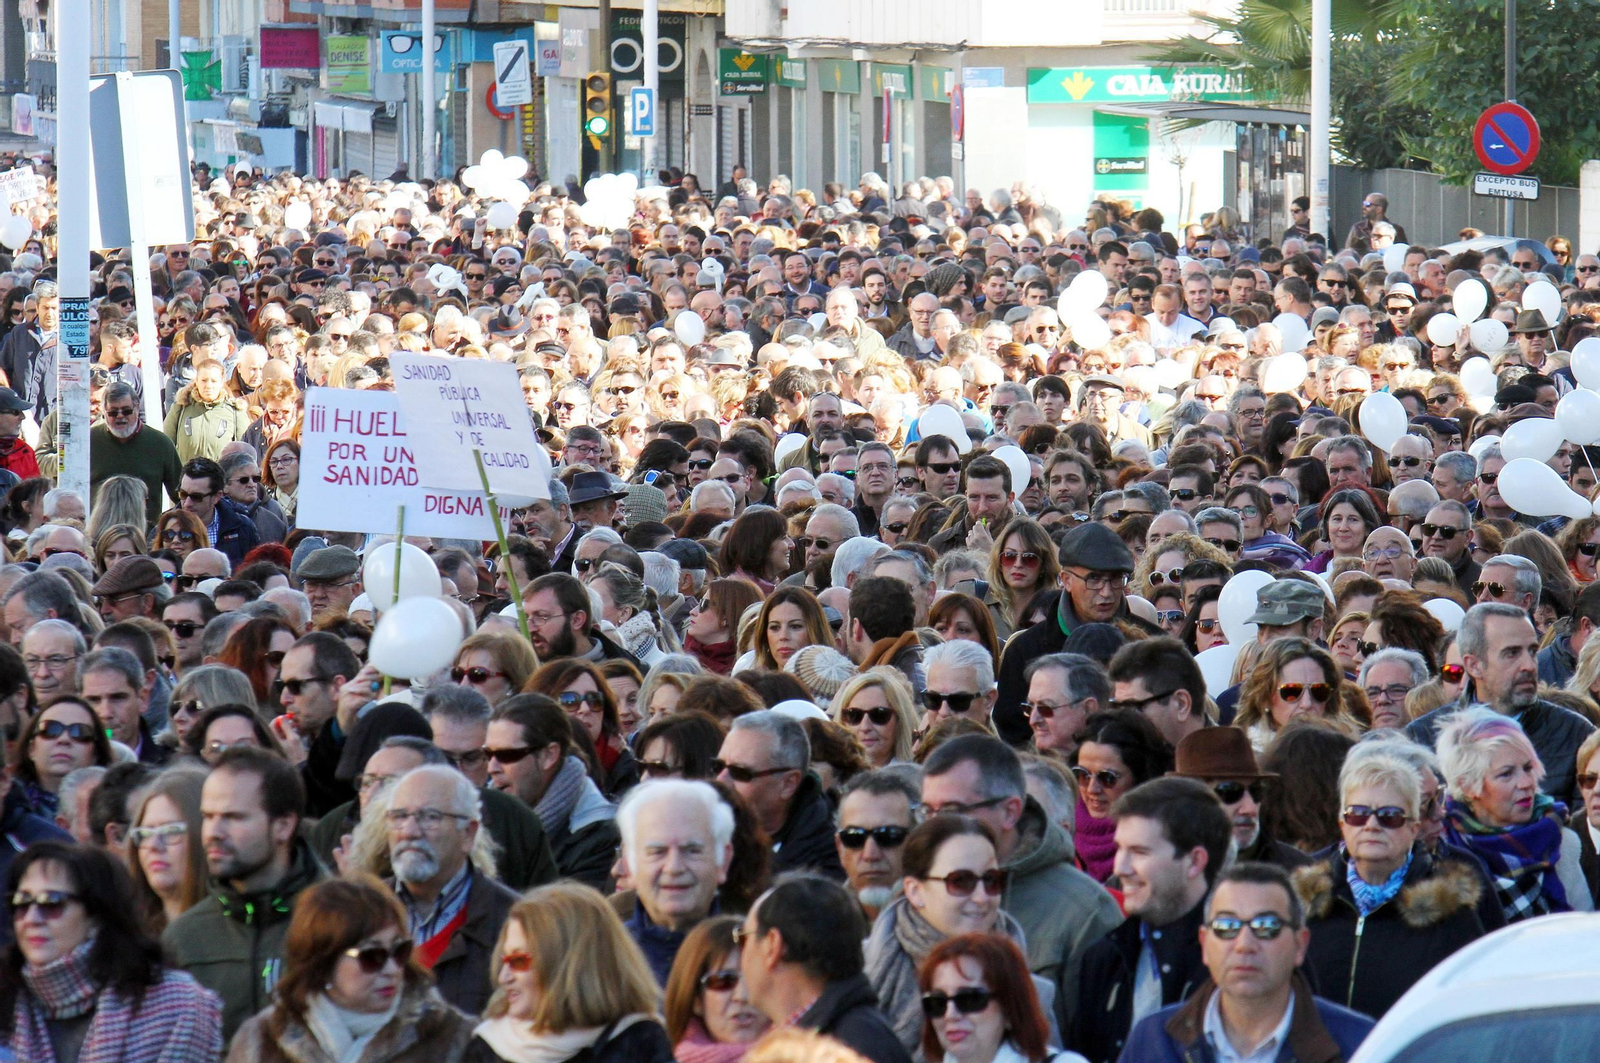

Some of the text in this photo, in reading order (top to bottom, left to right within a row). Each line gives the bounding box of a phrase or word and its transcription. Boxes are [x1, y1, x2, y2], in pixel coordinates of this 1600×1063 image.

[330, 51, 365, 62] DENISE
[1107, 75, 1168, 95] CAJA
[1477, 176, 1536, 187] EXCEPTO BUS
[1488, 188, 1524, 198] EMTUSA
[402, 365, 451, 381] SANIDAD
[452, 411, 511, 430] UNIVERSAL
[455, 431, 485, 446] Y DE
[329, 442, 415, 464] POR UN
[483, 452, 530, 469] CALIDAD
[323, 464, 419, 486] SANIDAD
[425, 495, 484, 516] DIGNA
